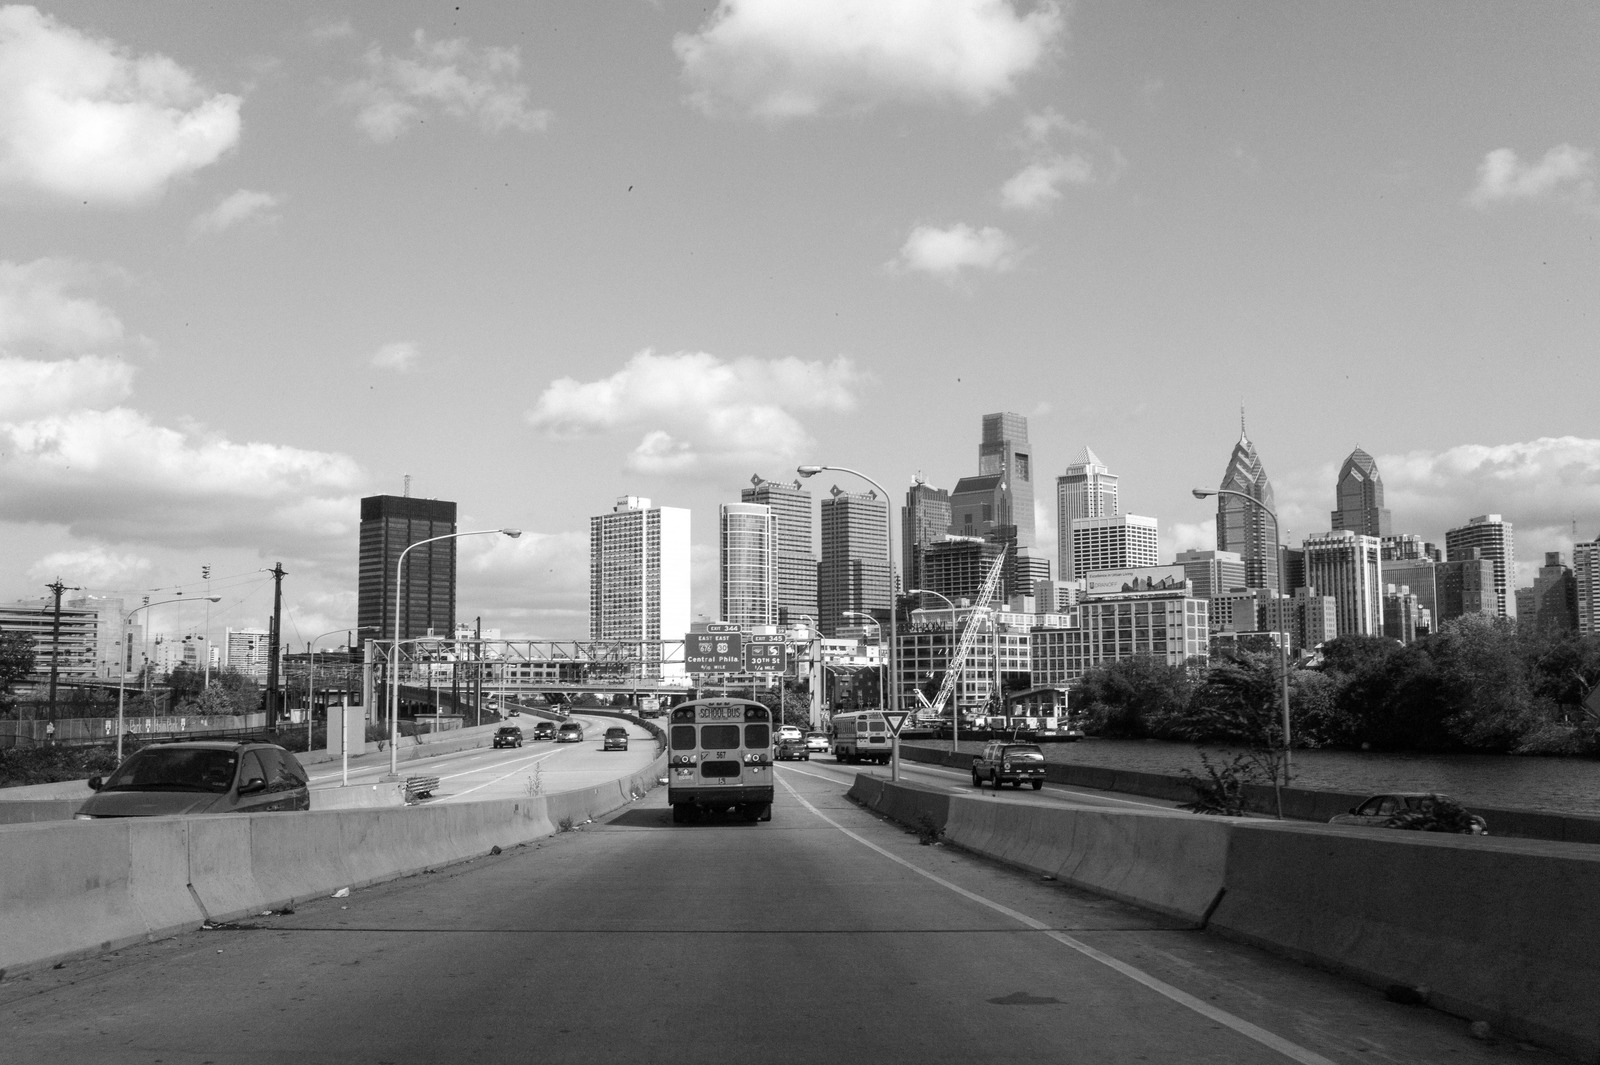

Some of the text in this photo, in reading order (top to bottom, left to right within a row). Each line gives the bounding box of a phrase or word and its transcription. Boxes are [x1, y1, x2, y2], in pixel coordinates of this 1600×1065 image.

[700, 708, 741, 718] SCHOOL BUS
[716, 751, 726, 759] 567
